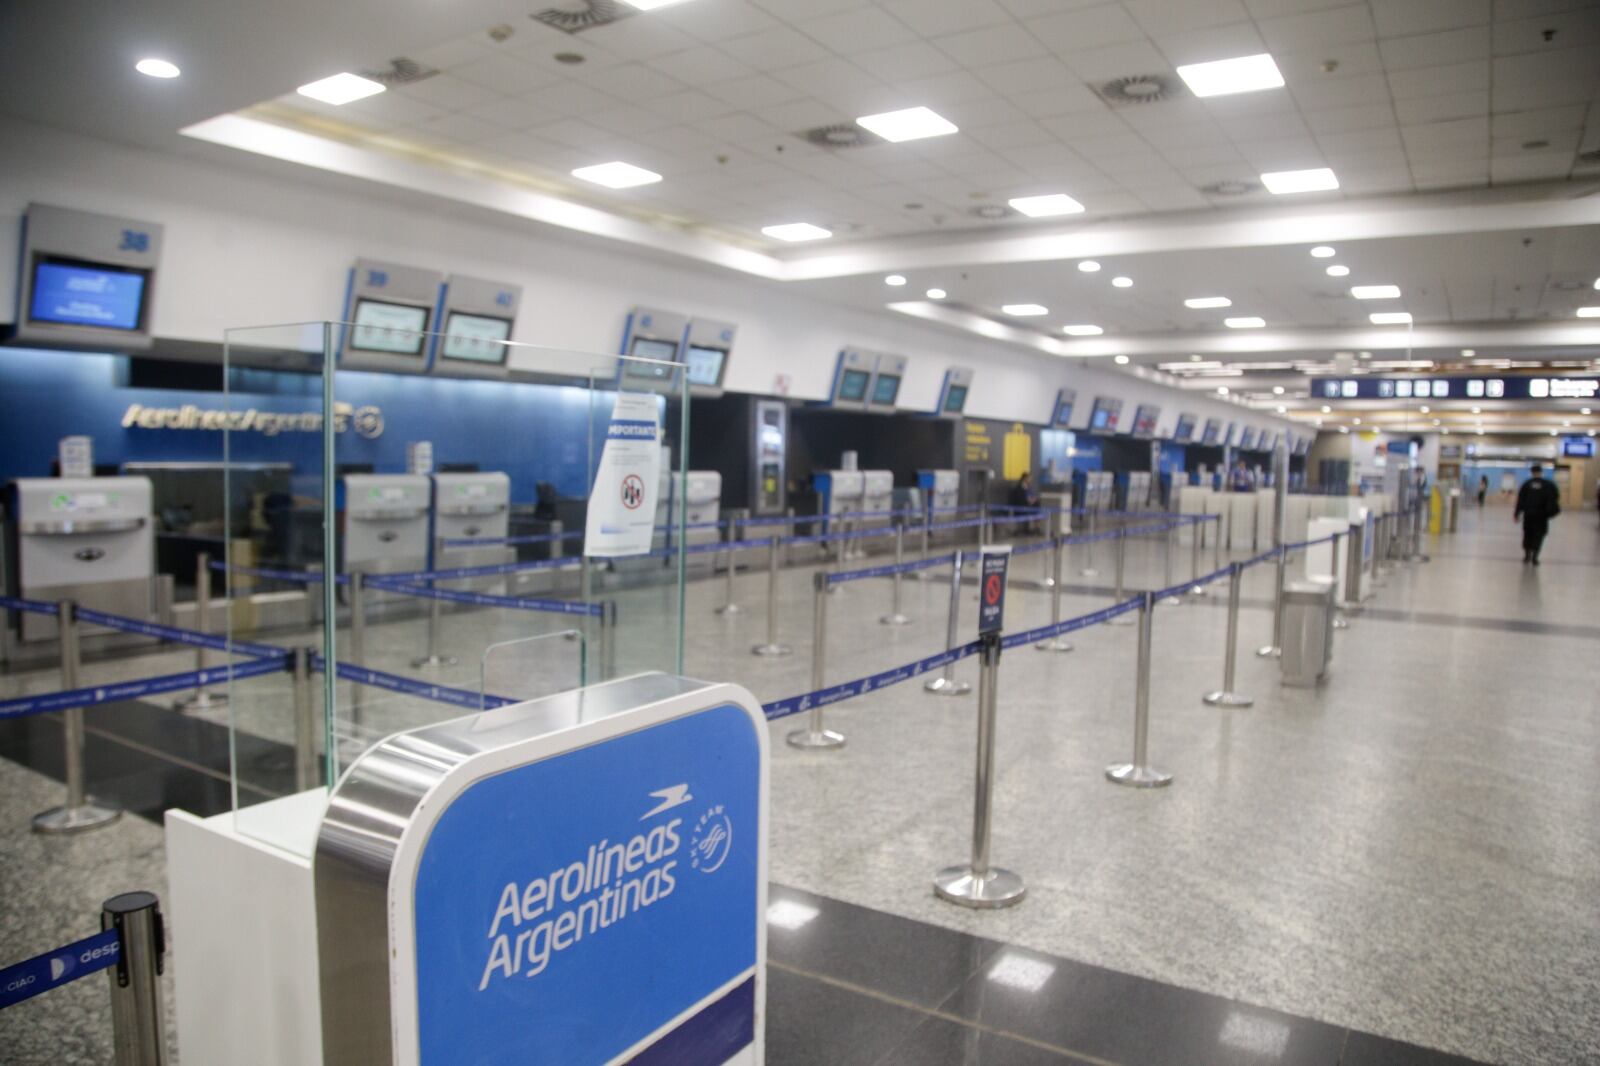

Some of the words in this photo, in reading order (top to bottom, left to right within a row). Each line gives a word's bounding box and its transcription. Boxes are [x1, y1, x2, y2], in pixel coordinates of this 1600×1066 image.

[478, 860, 677, 992] Argentinas
[488, 817, 682, 938] Aerolíneas
[80, 940, 120, 964] desp
